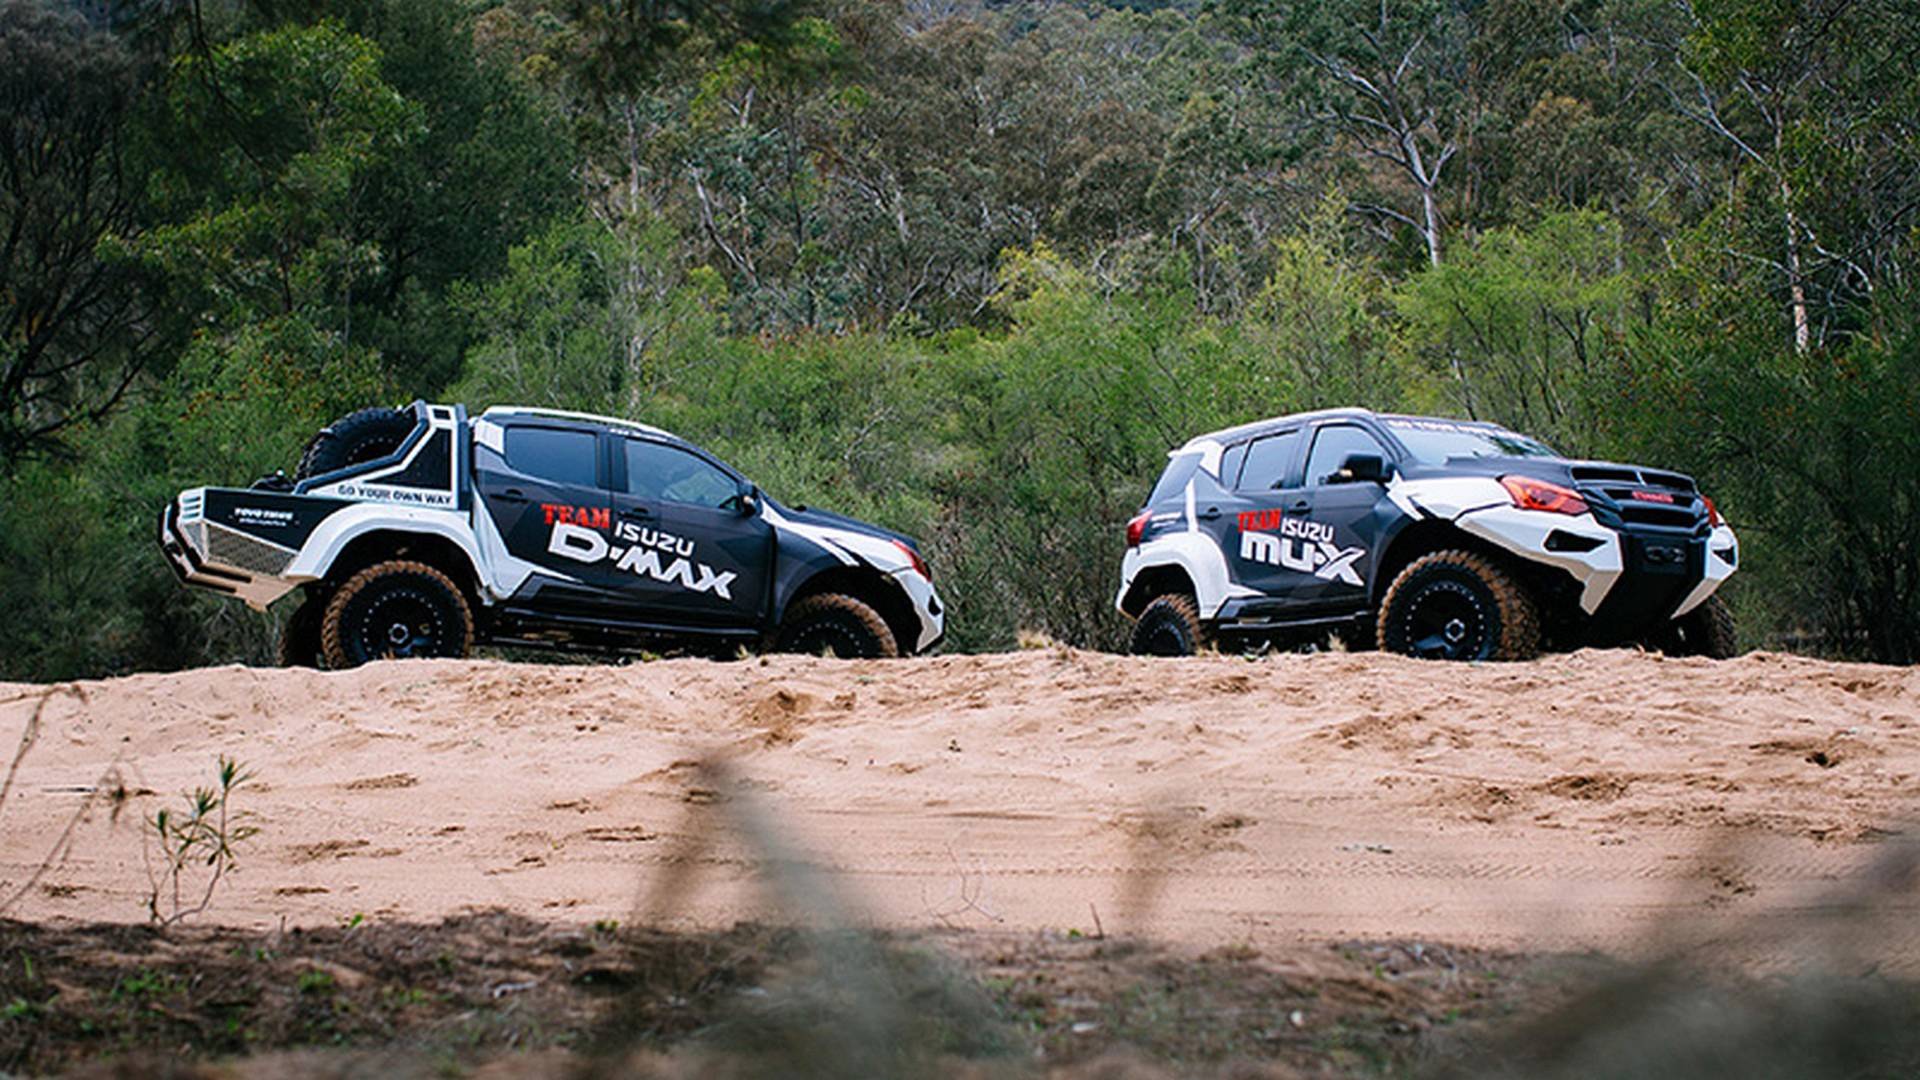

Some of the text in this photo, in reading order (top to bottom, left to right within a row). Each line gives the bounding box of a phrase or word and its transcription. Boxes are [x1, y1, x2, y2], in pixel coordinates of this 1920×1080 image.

[358, 487, 391, 499] YOUR
[393, 490, 423, 502] OWN
[424, 494, 451, 504] WAY
[540, 503, 694, 557] TEAM ISUZU
[1237, 508, 1334, 542] TEAM ISUZU
[548, 520, 737, 600] D-MAX
